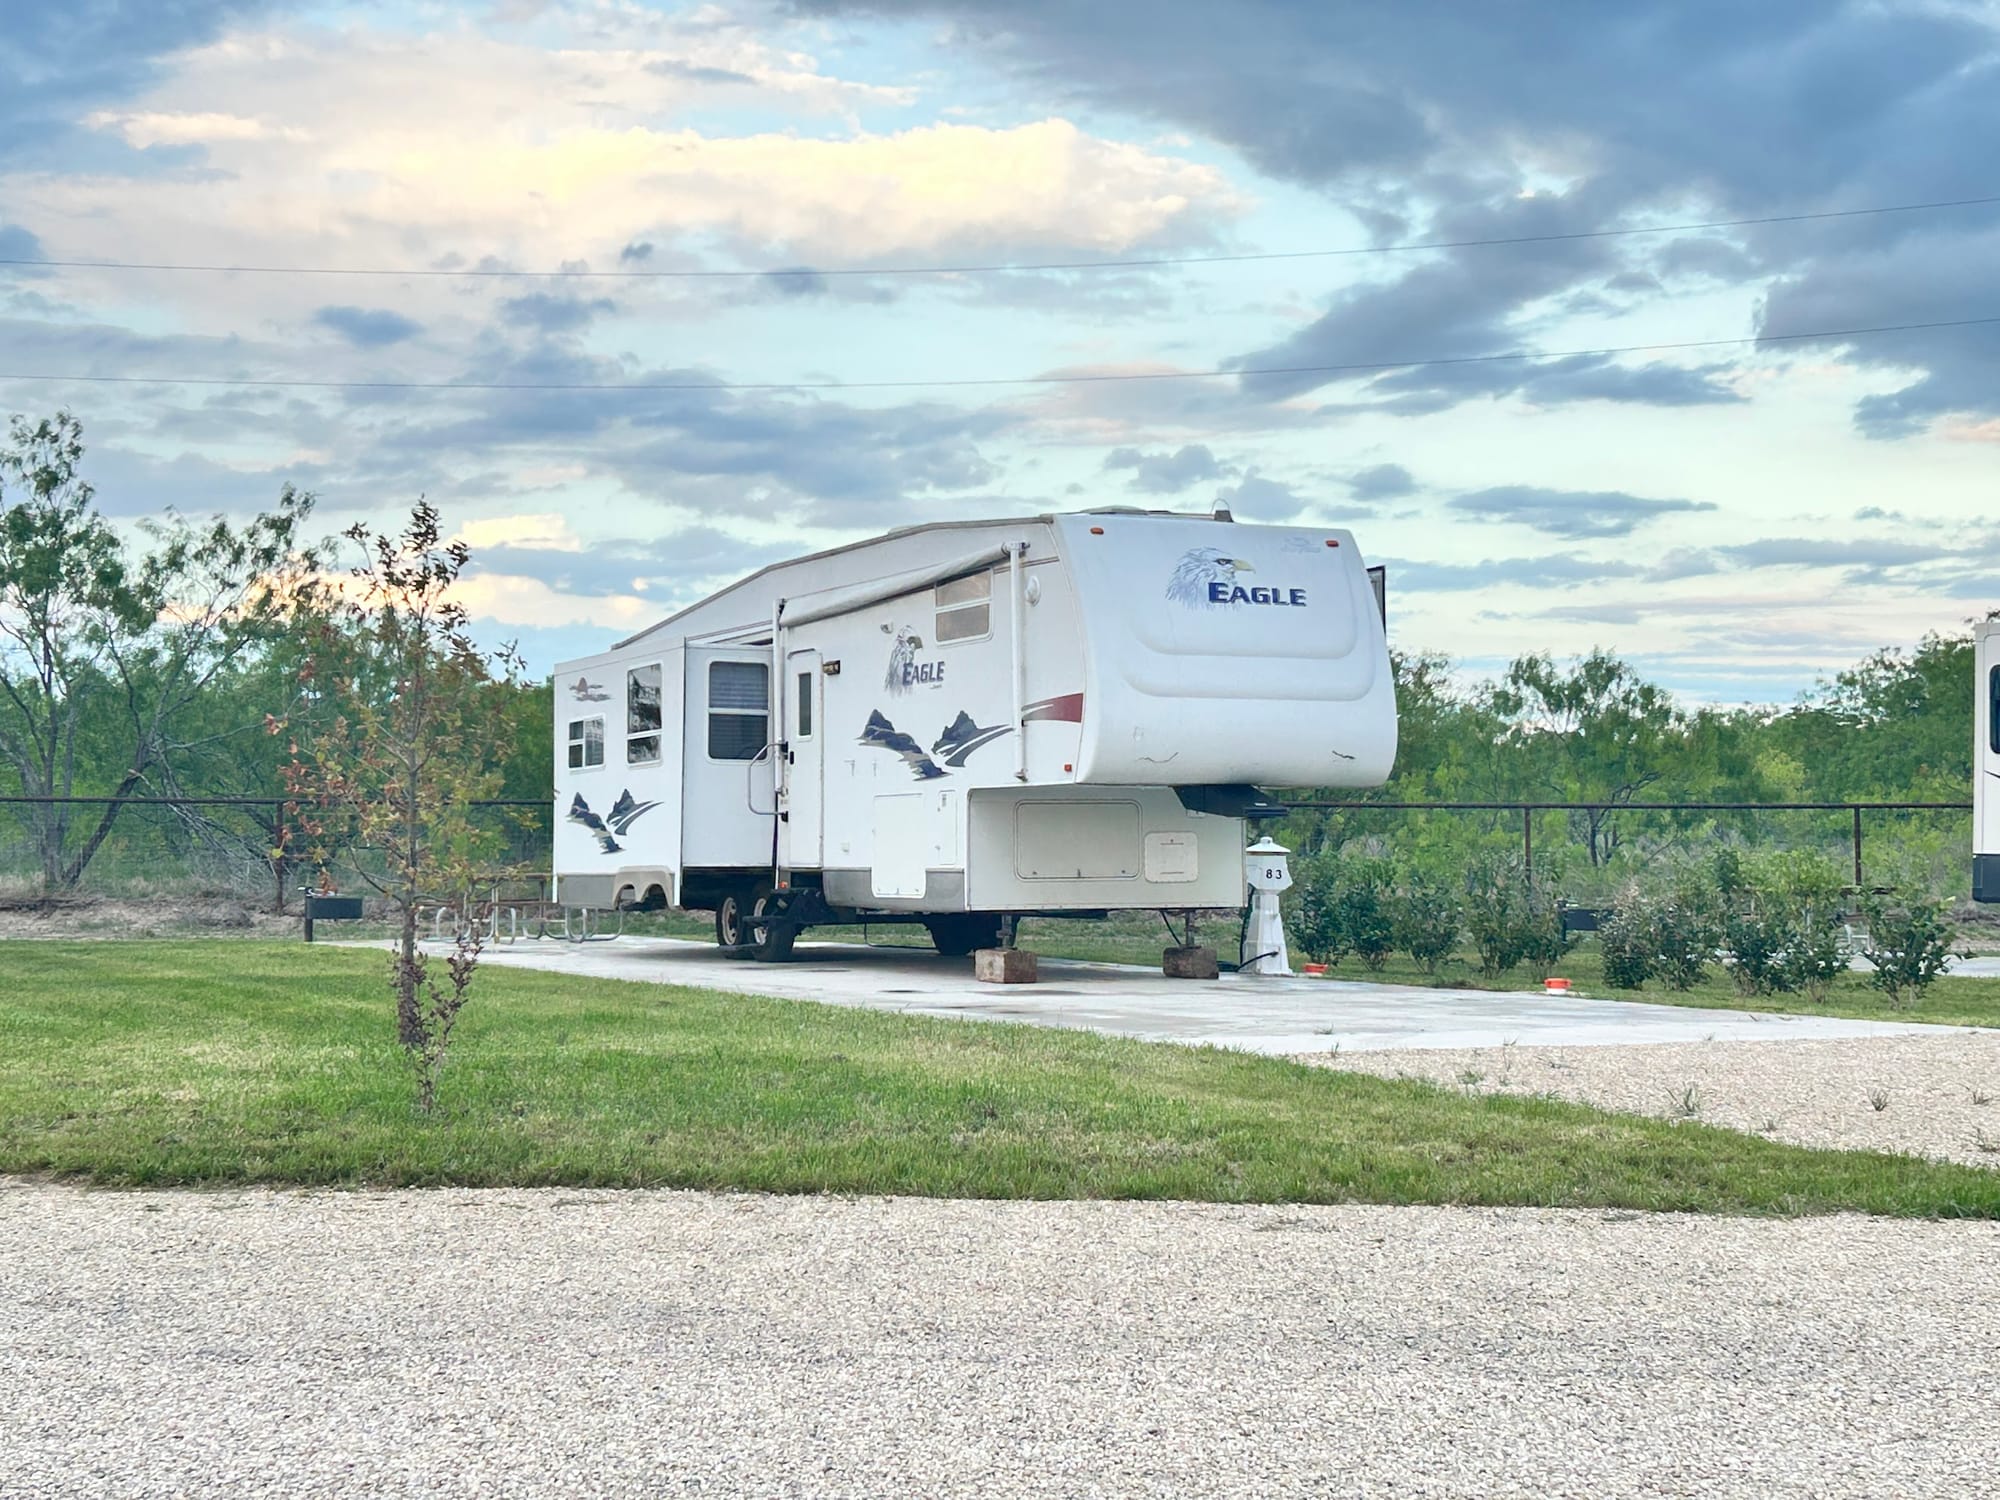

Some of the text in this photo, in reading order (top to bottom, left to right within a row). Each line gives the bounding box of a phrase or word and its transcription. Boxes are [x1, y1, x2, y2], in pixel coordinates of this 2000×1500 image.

[1208, 582, 1307, 607] EAGLE
[902, 661, 945, 686] EAGLE
[1266, 869, 1282, 880] 83
